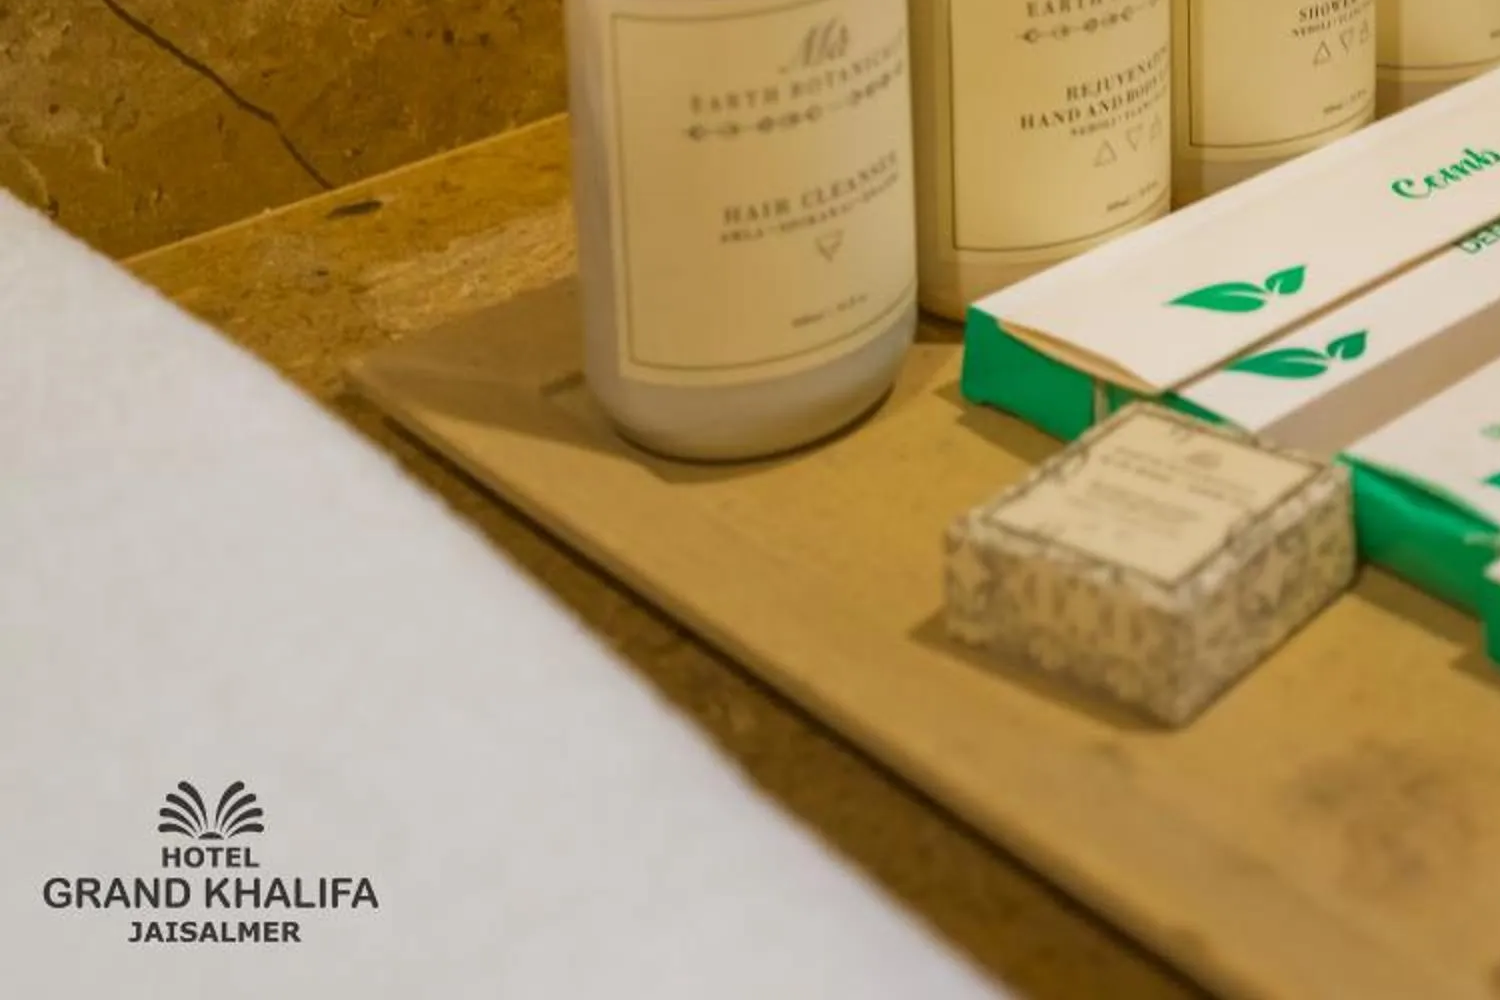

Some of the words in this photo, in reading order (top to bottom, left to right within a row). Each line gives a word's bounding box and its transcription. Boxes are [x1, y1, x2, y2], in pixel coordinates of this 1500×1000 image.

[689, 85, 781, 115] EARTH
[1019, 106, 1082, 131] HAND
[1086, 95, 1124, 120] AND
[722, 197, 793, 227] HAIR
